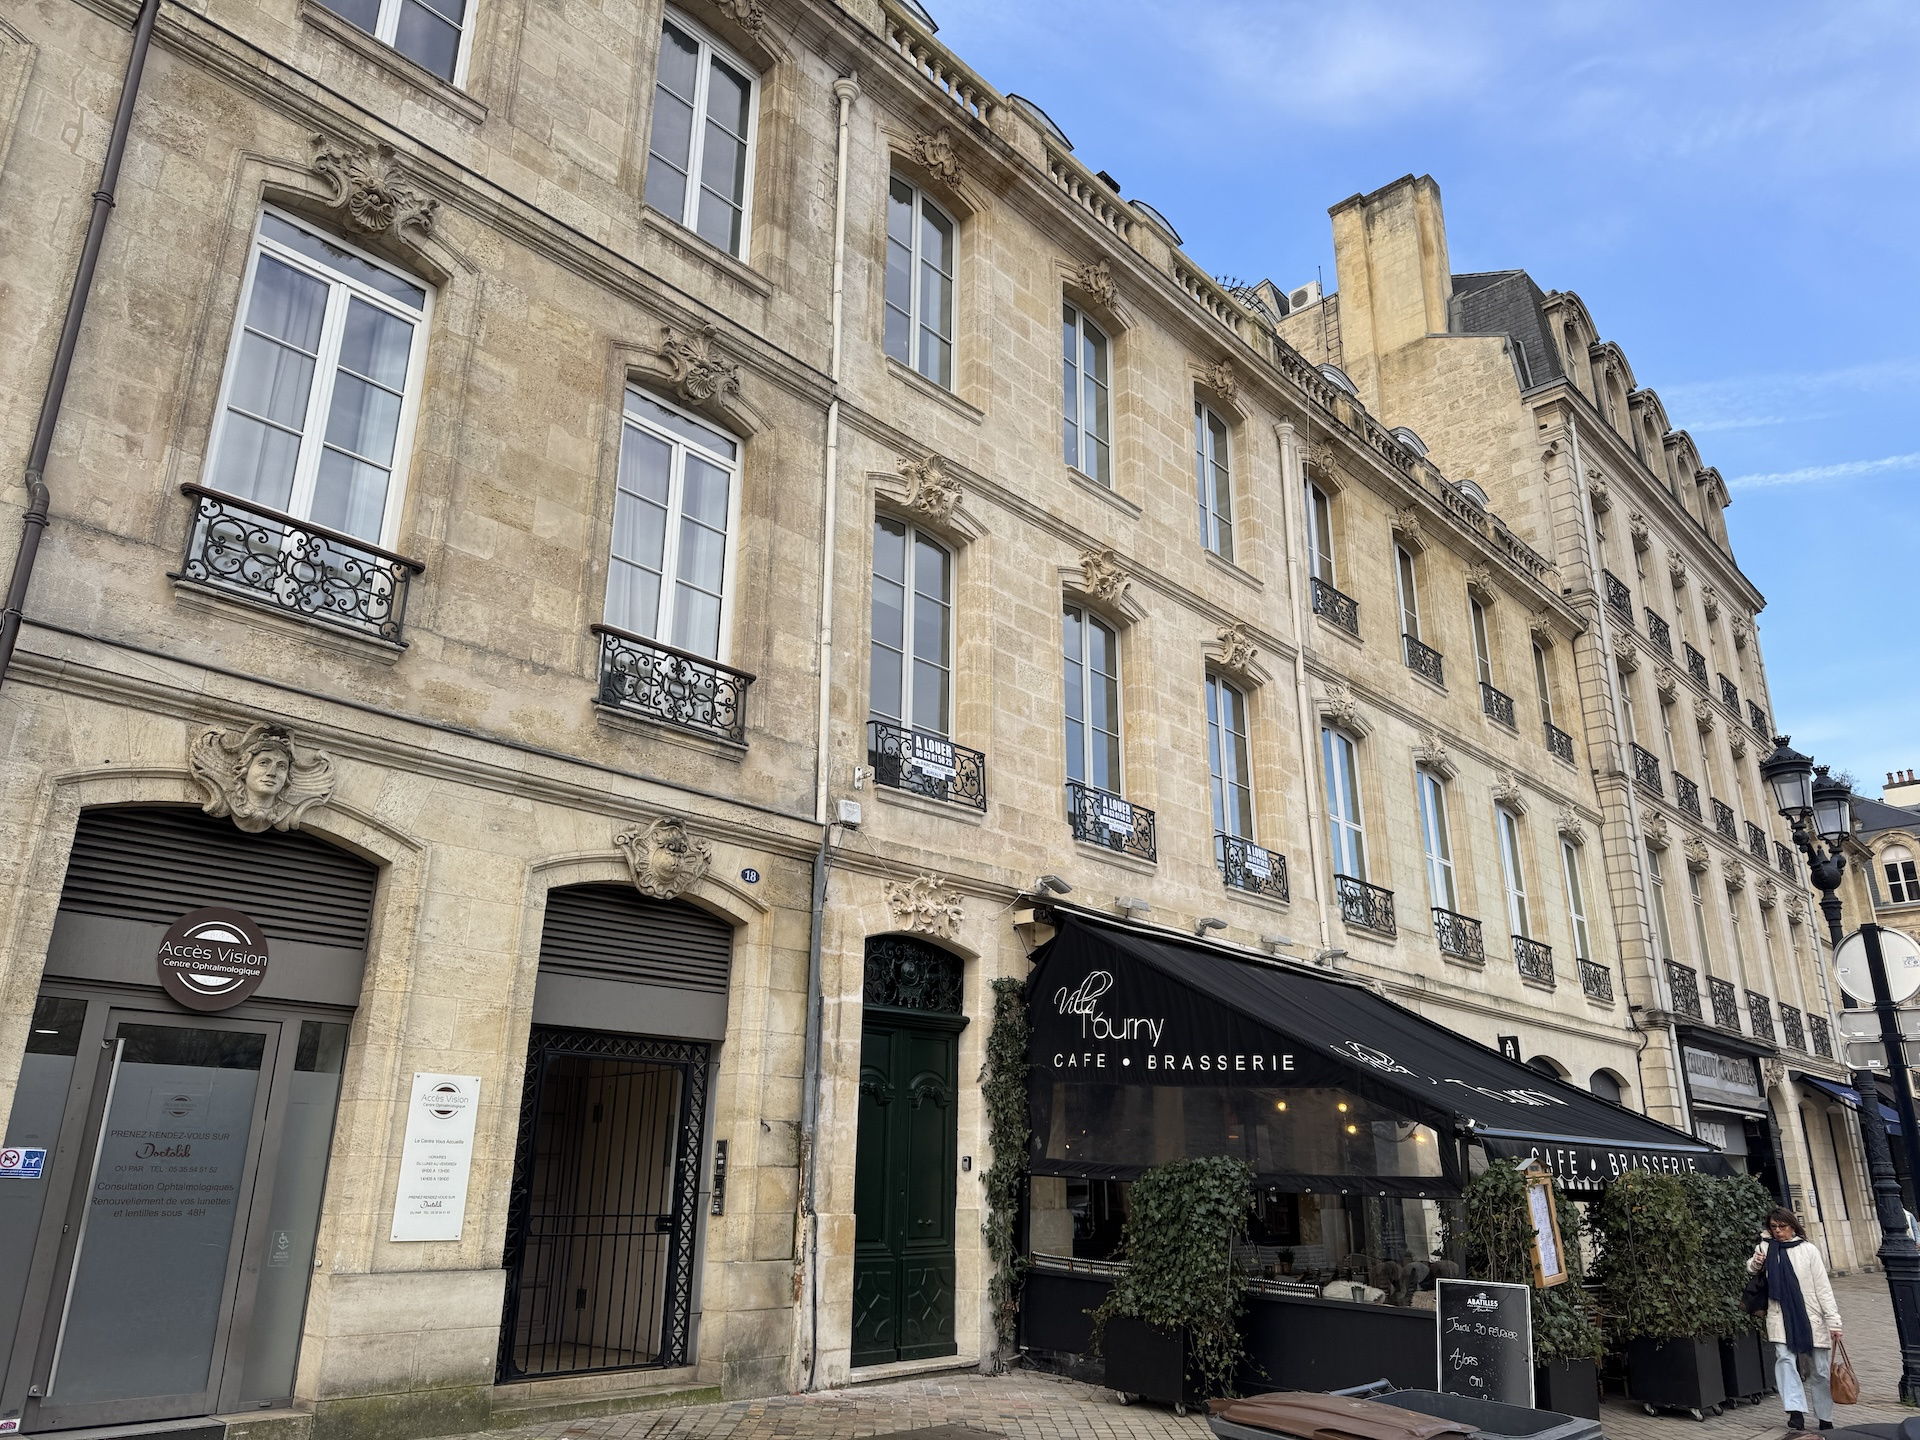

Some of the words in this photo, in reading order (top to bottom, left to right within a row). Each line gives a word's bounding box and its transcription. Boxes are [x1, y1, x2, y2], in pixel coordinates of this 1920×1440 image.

[916, 735, 922, 748] A
[924, 737, 952, 758] LOUER
[1103, 796, 1108, 808] A
[1109, 797, 1131, 816] LOUER
[1252, 845, 1268, 861] LOUER
[744, 870, 757, 882] 18
[159, 941, 212, 960] Accès
[217, 947, 268, 966] Vision
[163, 958, 191, 968] Centre
[192, 961, 260, 976] Ophtalmologique
[1077, 1010, 1164, 1047] Tourny
[1053, 1052, 1106, 1068] CAFE
[1147, 1054, 1295, 1071] BRASSERIE
[421, 1093, 444, 1102] Accès
[446, 1095, 469, 1103] Vision
[110, 1130, 148, 1139] PRENEZ
[148, 1131, 211, 1140] RENDEZ-VOUS
[135, 1142, 192, 1160] Doctolib
[97, 1182, 154, 1191] Consultation
[156, 1182, 234, 1193] Ophtalmologiques
[167, 1197, 177, 1205] de
[197, 1197, 231, 1206] lunettes
[113, 1210, 122, 1218] et
[124, 1209, 159, 1218] lentilles
[187, 1208, 206, 1217] 48H
[1466, 1298, 1499, 1308] ABATILLES
[1445, 1316, 1472, 1334] Jeudi
[1474, 1322, 1487, 1336] 20
